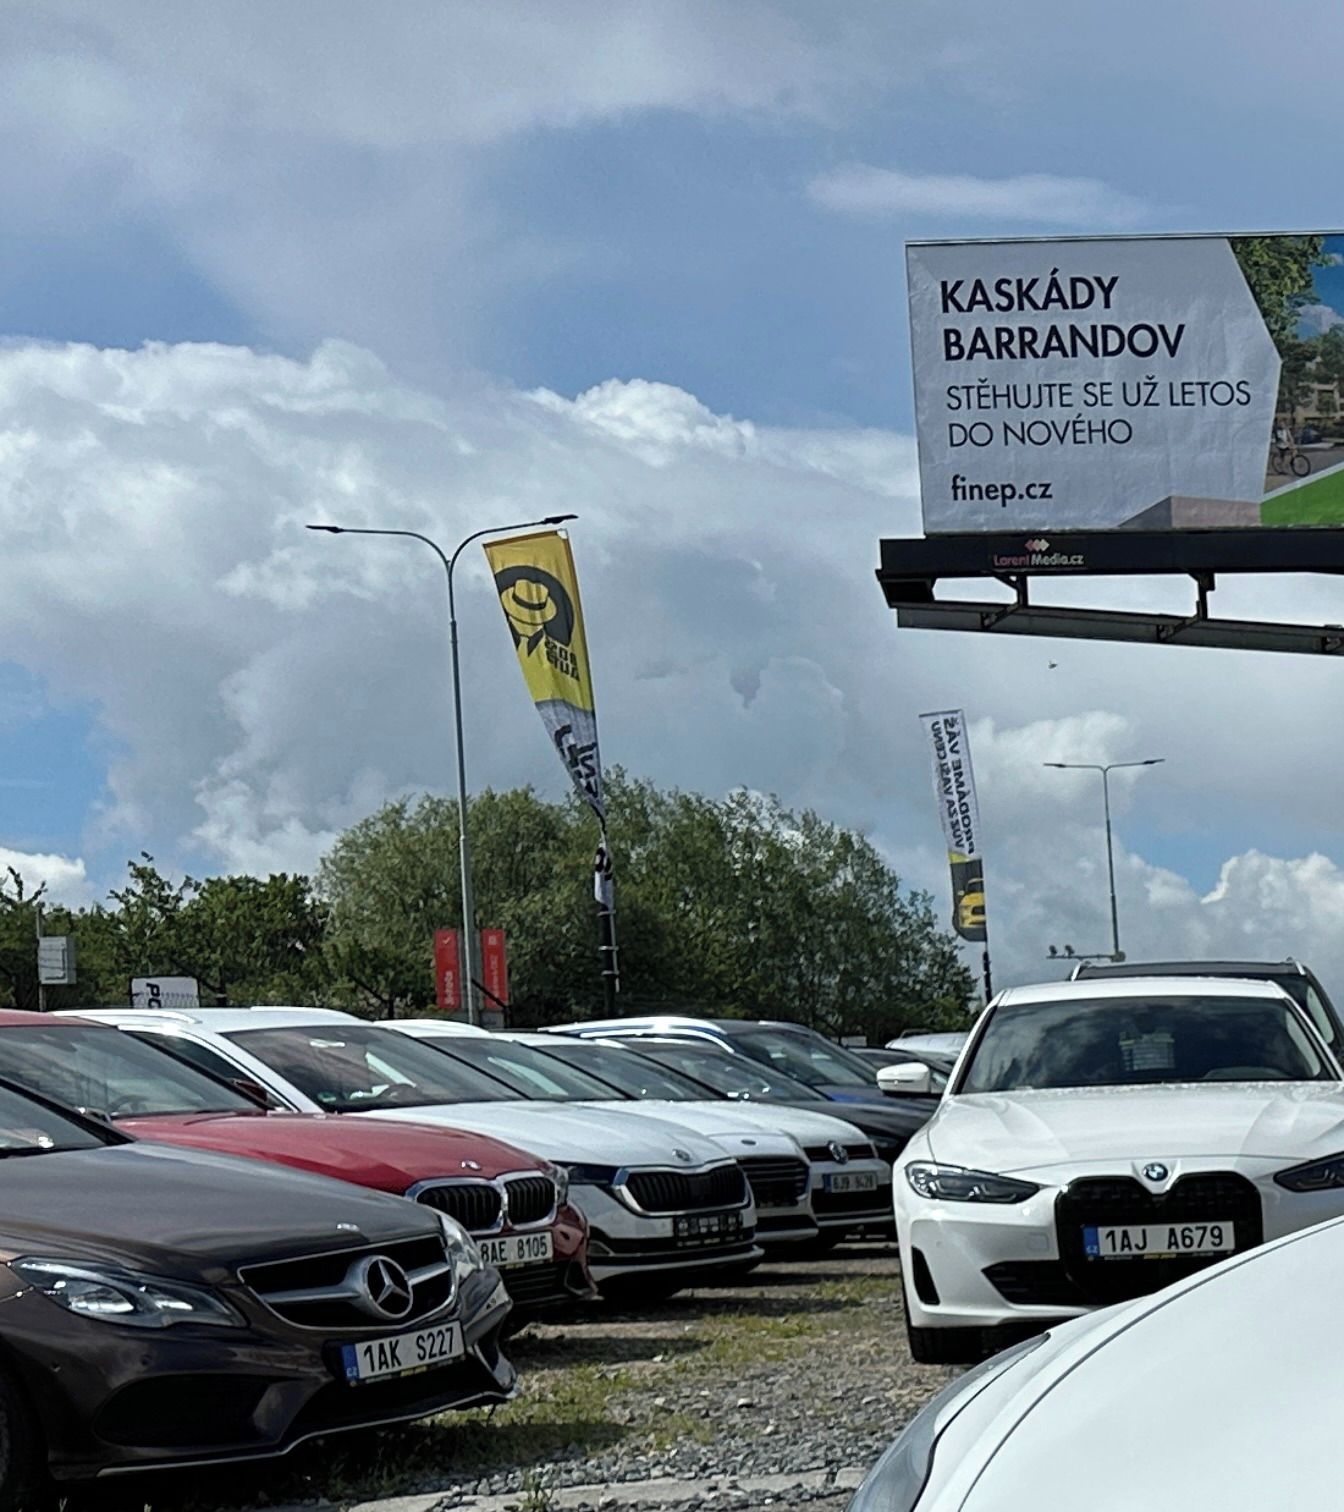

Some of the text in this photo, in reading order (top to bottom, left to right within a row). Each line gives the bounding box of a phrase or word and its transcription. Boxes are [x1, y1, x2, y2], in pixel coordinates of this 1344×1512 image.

[940, 267, 1119, 314] KASKÁDY
[944, 323, 1186, 361] BARRANDOV
[947, 375, 1251, 411] STĚHUJTE SE UŽ LETOS
[948, 413, 1133, 447] DO NOVÉHO
[951, 473, 1053, 508] finep.cz
[480, 1236, 548, 1263] 8AE 8105
[1105, 1225, 1224, 1252] 1AJ A679
[364, 1327, 454, 1373] 1AK S227
